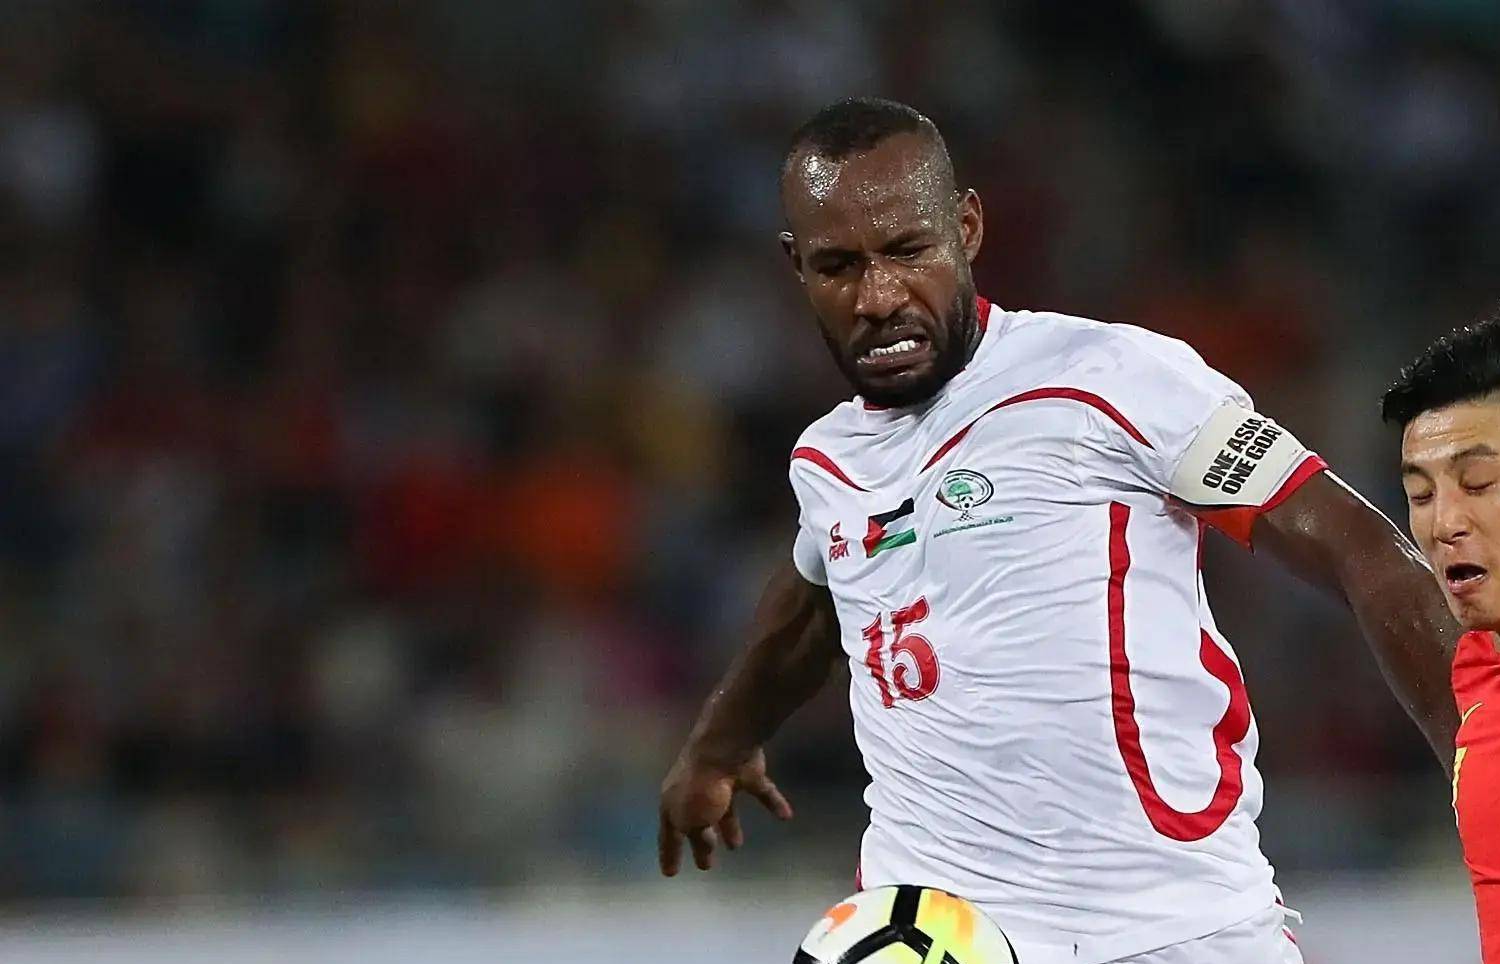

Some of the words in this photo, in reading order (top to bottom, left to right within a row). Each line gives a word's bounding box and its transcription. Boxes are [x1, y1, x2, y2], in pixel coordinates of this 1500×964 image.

[1203, 449, 1239, 489] ONE
[1226, 418, 1267, 453] ASIA
[1221, 457, 1257, 495] ONE
[861, 595, 940, 708] 15
